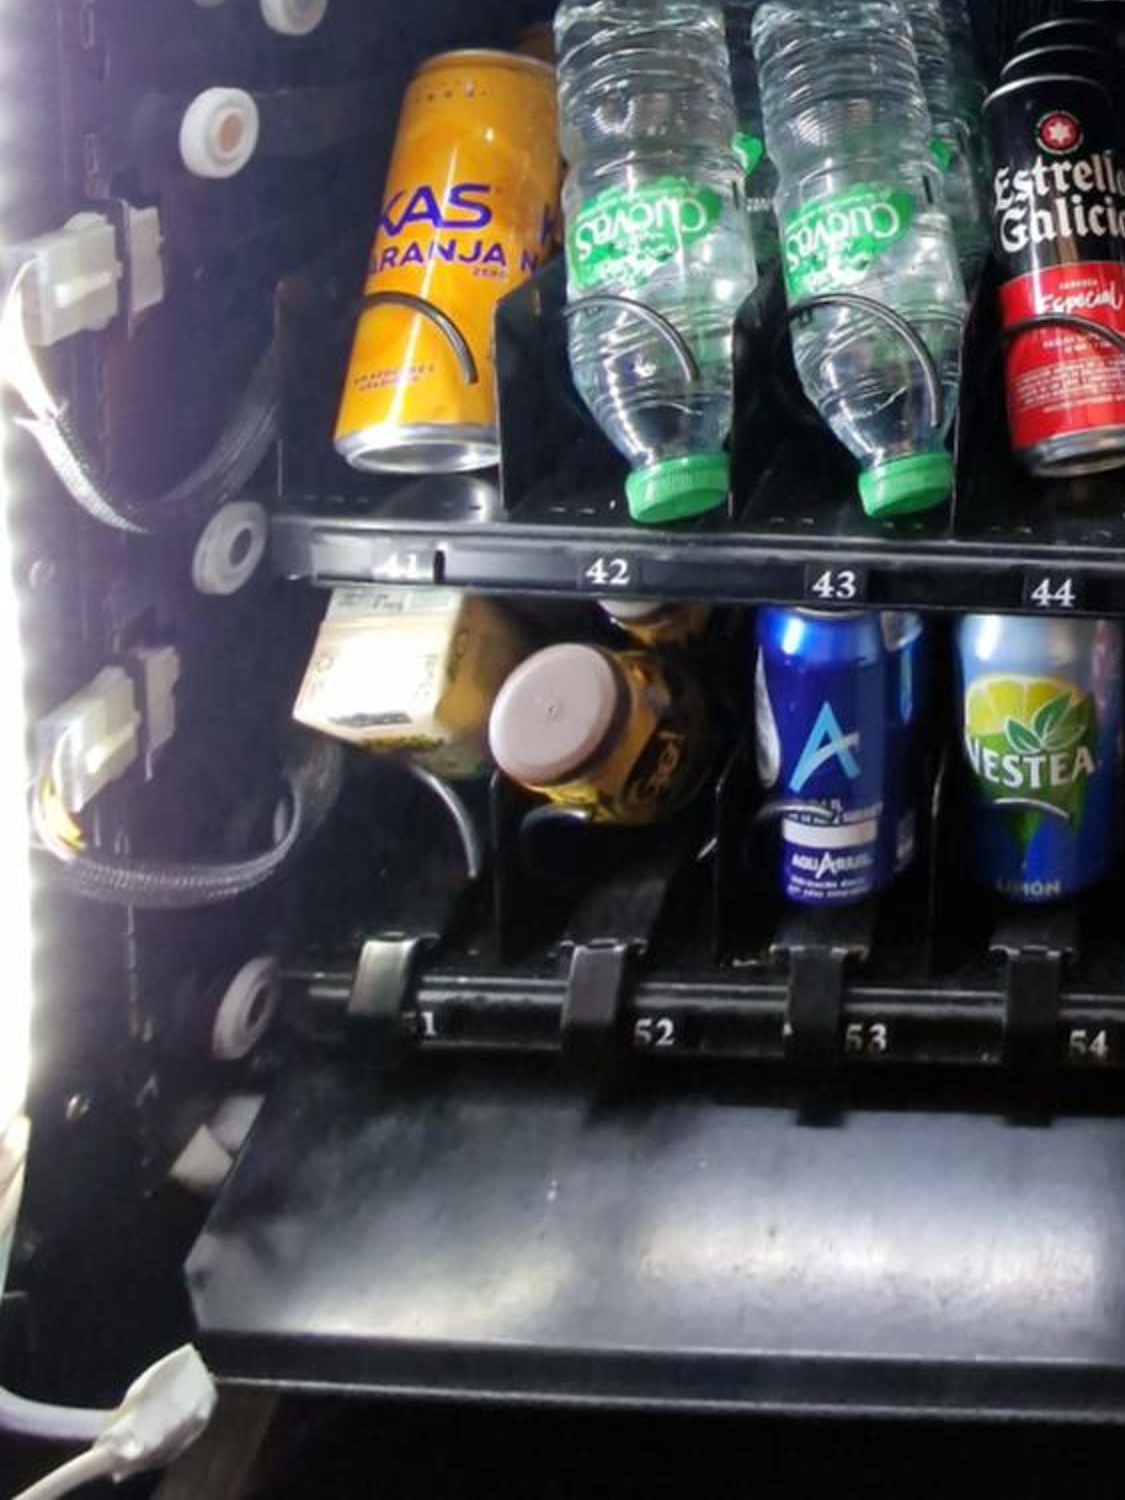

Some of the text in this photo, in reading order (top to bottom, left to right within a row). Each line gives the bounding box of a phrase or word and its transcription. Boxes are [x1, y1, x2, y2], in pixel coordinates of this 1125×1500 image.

[585, 558, 631, 586] 42
[812, 570, 857, 599] 43
[1031, 579, 1076, 607] 44
[967, 735, 1097, 789] NESTEA
[633, 1017, 677, 1047] 52
[846, 1022, 888, 1052] 53
[1069, 1029, 1111, 1058] 54
